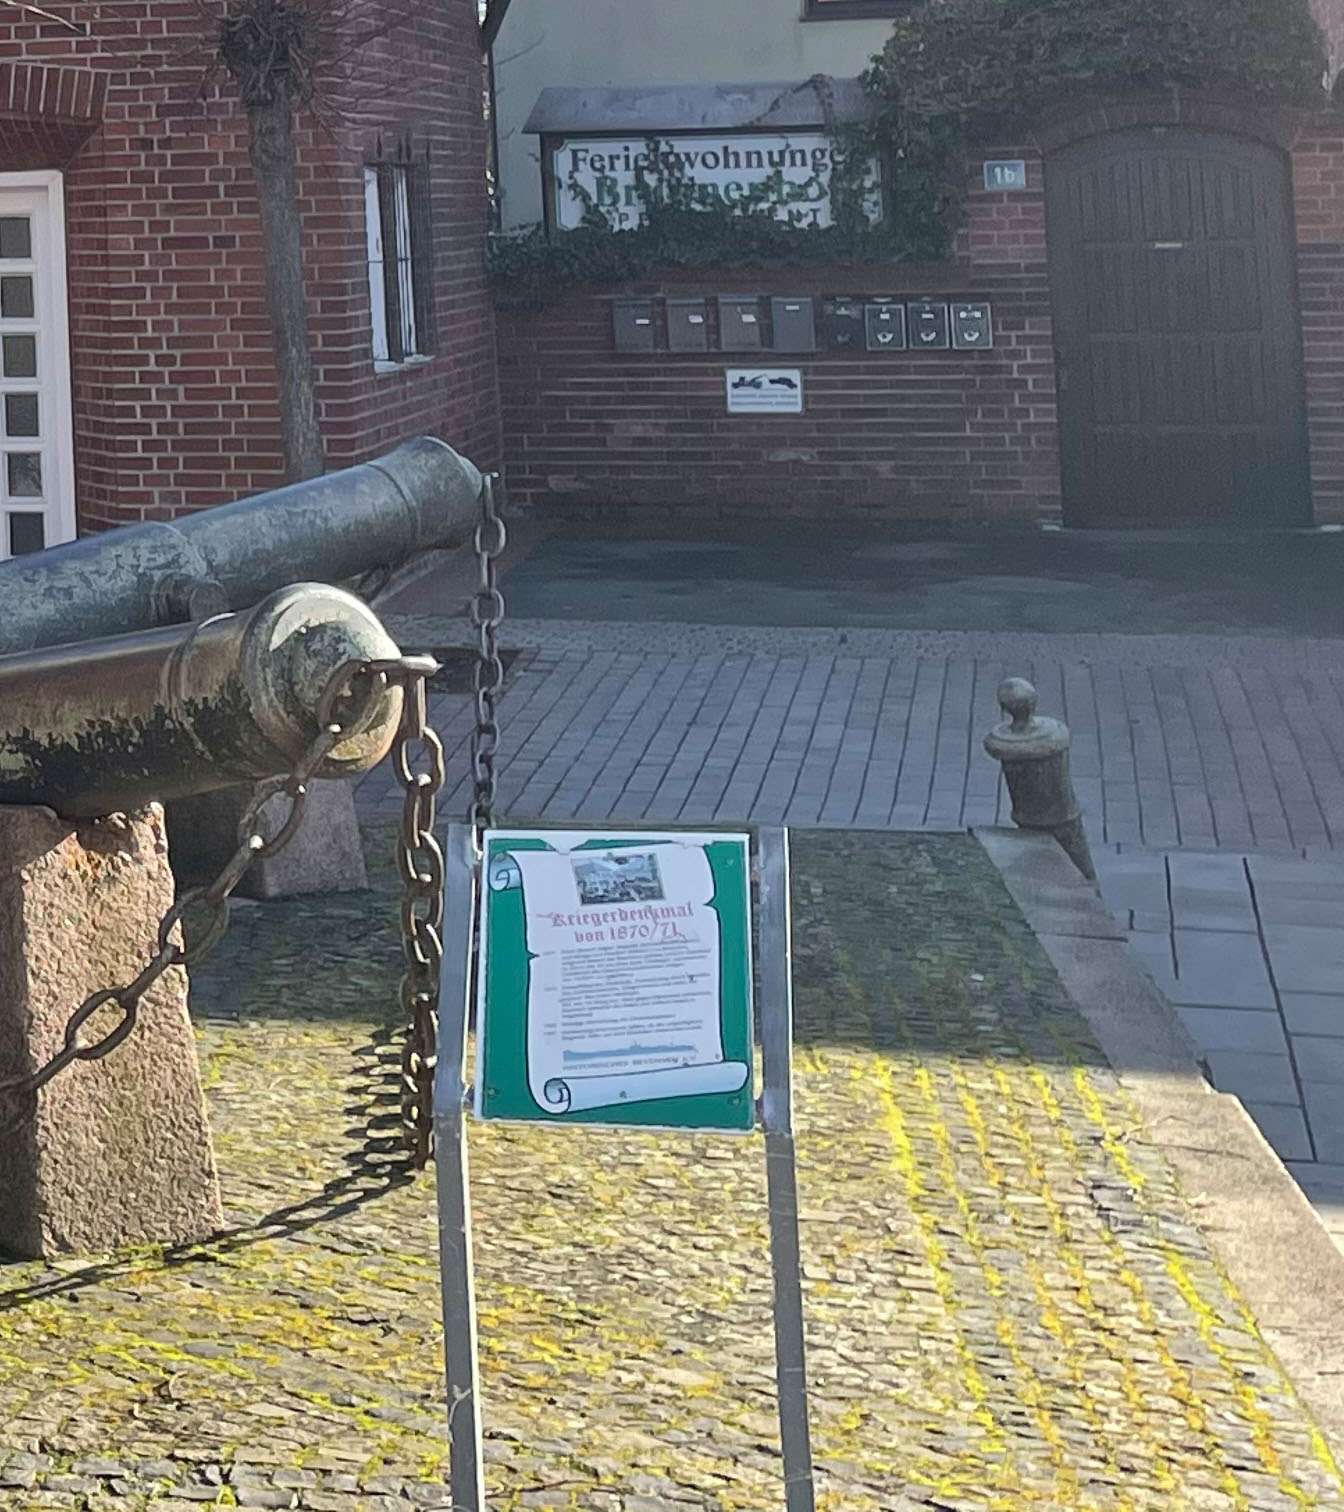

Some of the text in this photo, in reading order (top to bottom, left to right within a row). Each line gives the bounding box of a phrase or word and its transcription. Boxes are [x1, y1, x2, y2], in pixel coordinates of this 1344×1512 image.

[994, 167, 1015, 184] 1b
[546, 901, 694, 928] Kriegerdenkmal
[574, 920, 682, 943] von 1870/71
